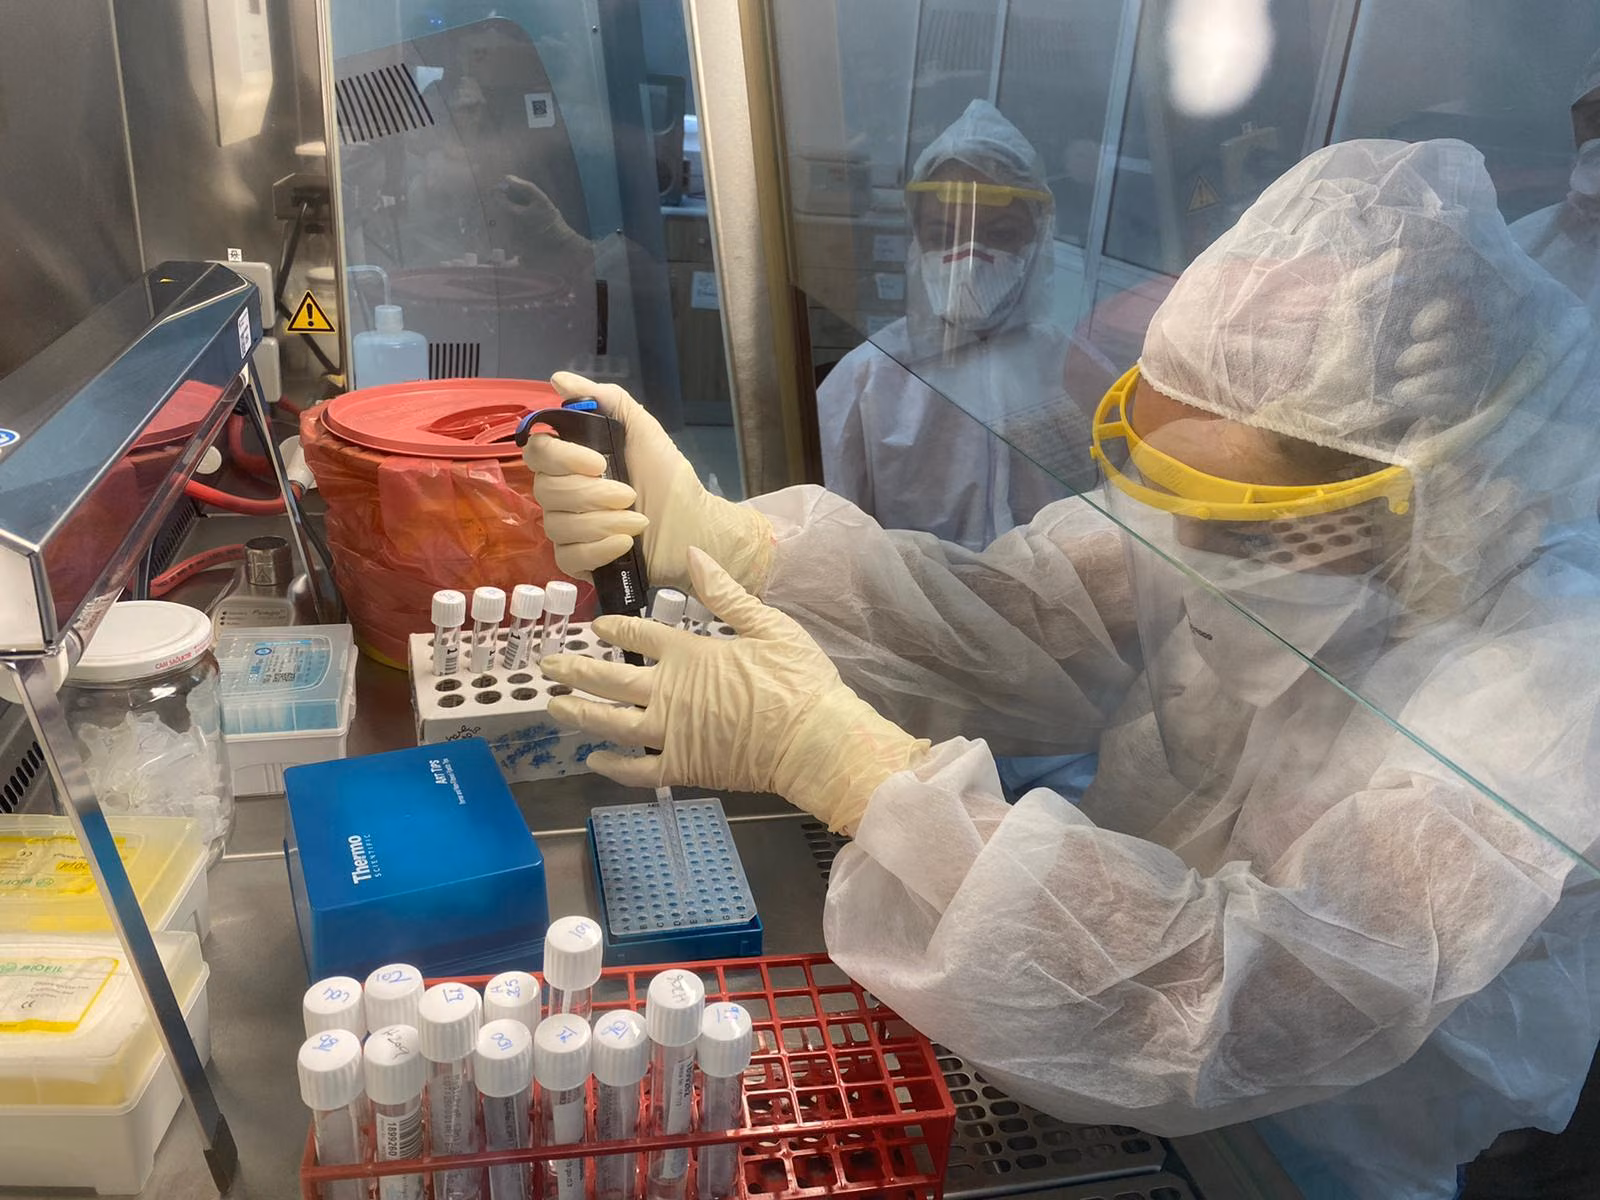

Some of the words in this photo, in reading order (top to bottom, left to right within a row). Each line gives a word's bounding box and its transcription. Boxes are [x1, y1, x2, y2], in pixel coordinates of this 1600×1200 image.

[621, 570, 633, 605] Thermo
[348, 835, 372, 885] Thermo
[364, 834, 382, 878] SCIENTIFIC
